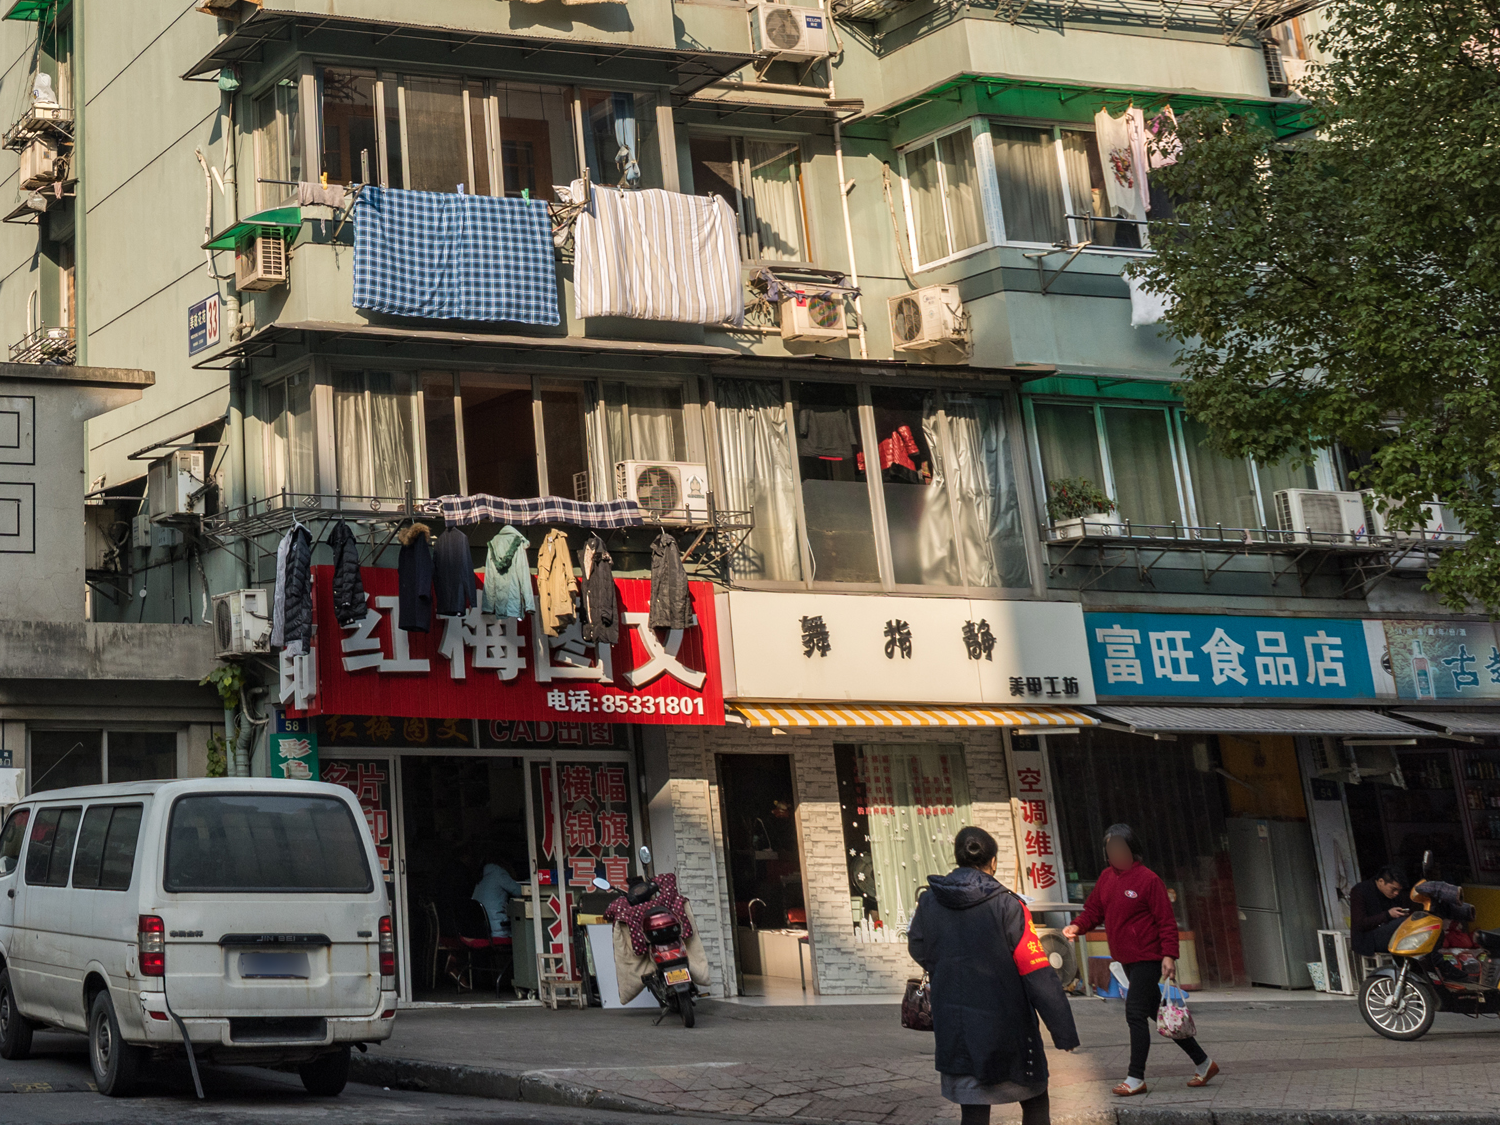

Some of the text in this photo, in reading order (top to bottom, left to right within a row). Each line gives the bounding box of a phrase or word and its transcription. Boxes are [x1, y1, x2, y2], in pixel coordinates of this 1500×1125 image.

[208, 300, 218, 339] 33
[341, 589, 707, 690] 红梅图文
[1095, 624, 1347, 688] 富旺食品店
[1008, 676, 1080, 697] 美甲工坊
[284, 720, 300, 732] 58
[325, 715, 469, 743] 红梅图文
[489, 718, 613, 746] CAD出图
[1019, 738, 1032, 749] 56
[278, 738, 313, 780] 彩色
[321, 762, 386, 802] 名片
[562, 765, 627, 804] 横幅
[1319, 788, 1333, 798] 54
[565, 810, 630, 848] 锦旗
[1017, 767, 1057, 890] 空调维修
[568, 854, 630, 893] 写真
